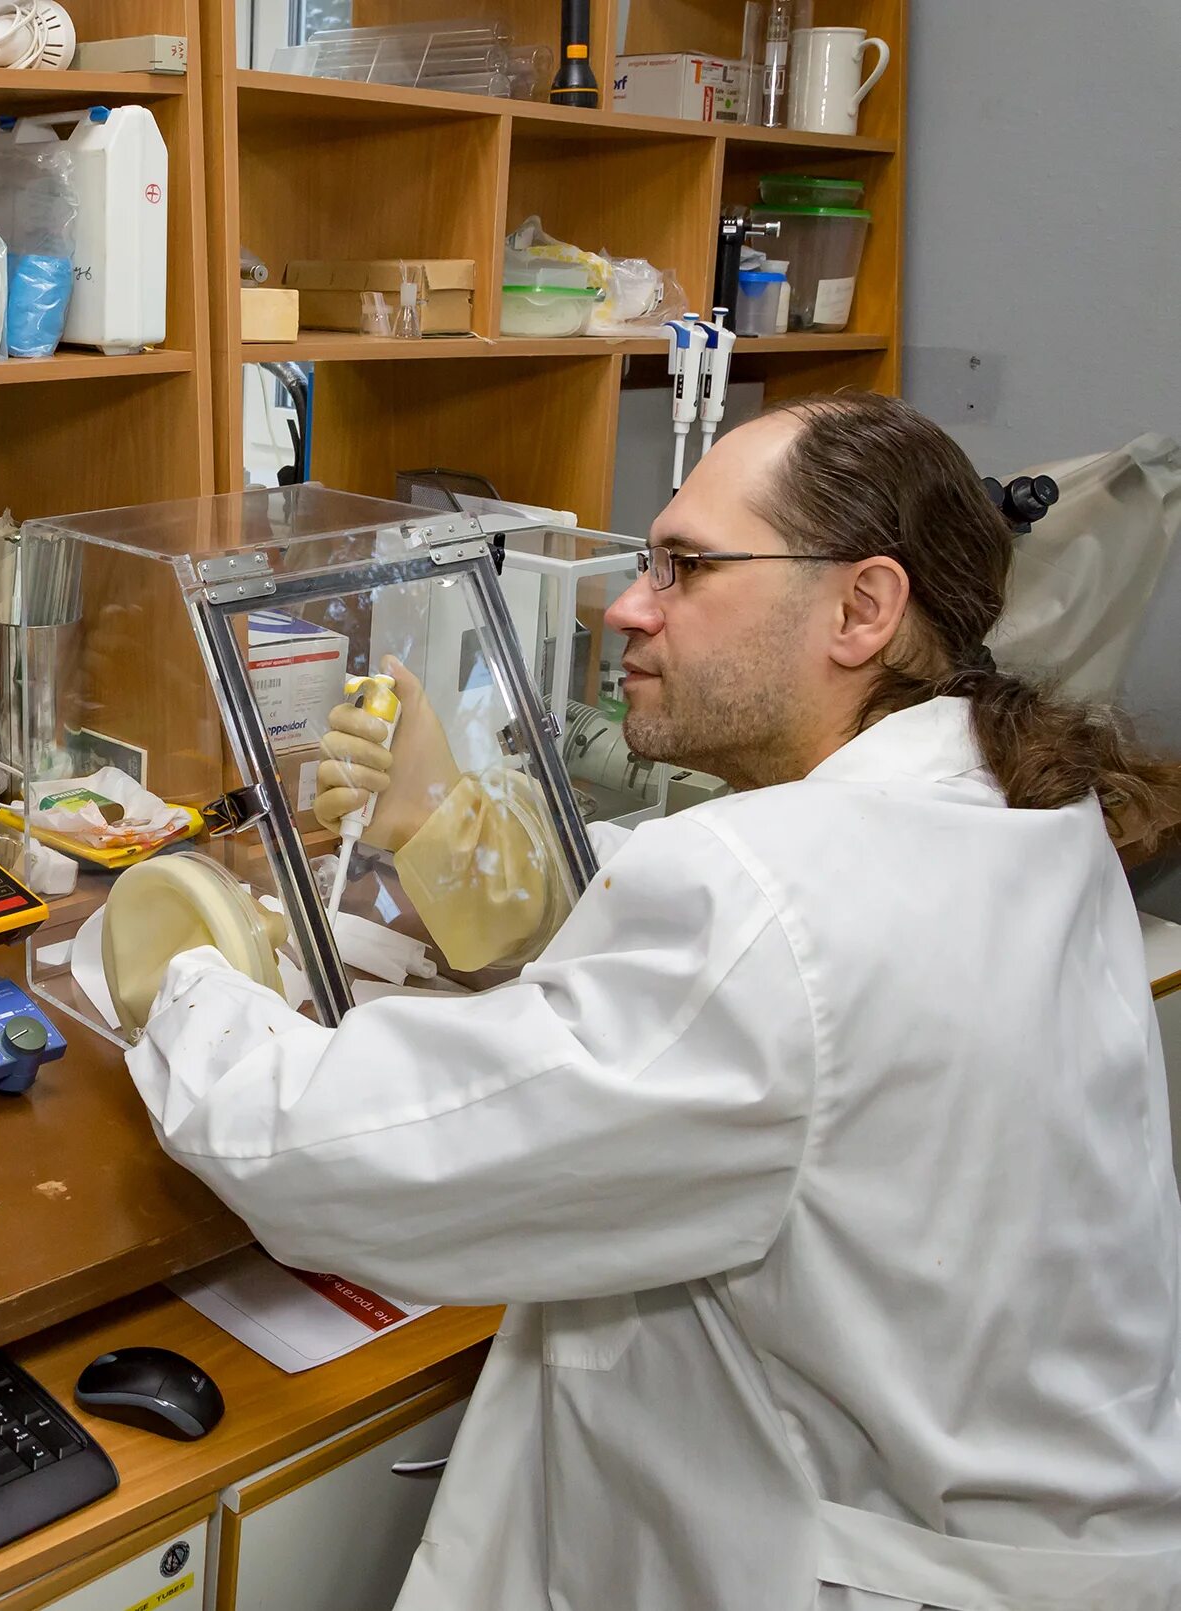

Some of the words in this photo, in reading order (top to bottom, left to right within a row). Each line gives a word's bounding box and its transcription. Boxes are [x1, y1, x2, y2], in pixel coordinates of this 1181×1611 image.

[51, 787, 89, 801] PHILIPS
[334, 1281, 375, 1313] трогать
[374, 1310, 393, 1324] Не
[156, 1582, 186, 1602] TUBES
